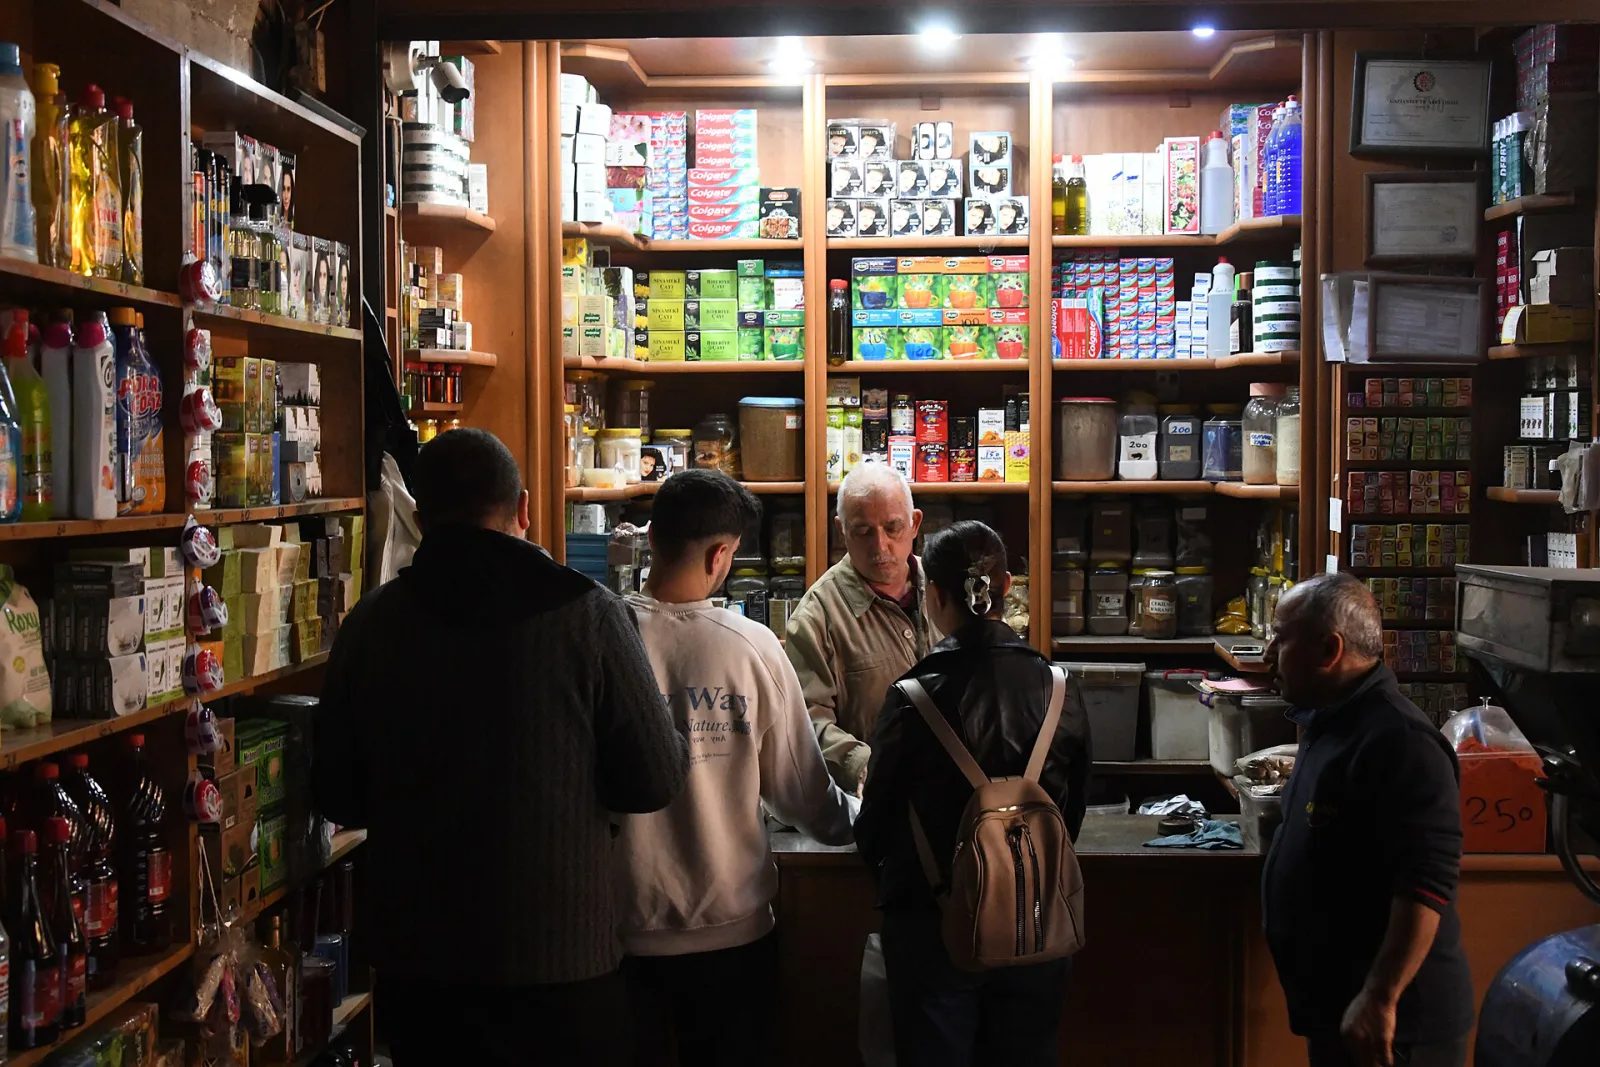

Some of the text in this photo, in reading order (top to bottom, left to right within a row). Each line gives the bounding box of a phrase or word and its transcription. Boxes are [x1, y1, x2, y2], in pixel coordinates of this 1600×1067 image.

[697, 112, 731, 122] Colgate
[697, 127, 731, 137] Colgate
[697, 142, 731, 151] Colgate
[697, 156, 731, 166] Colgate
[690, 170, 732, 181] Colgate
[690, 188, 732, 199] Colgate
[691, 206, 732, 217] Colgate
[691, 223, 732, 235] Colgate
[1089, 319, 1097, 357] Colgate
[1171, 425, 1191, 434] 200
[1129, 441, 1148, 449] 200
[685, 686, 748, 719] Way
[1466, 796, 1533, 834] 250
